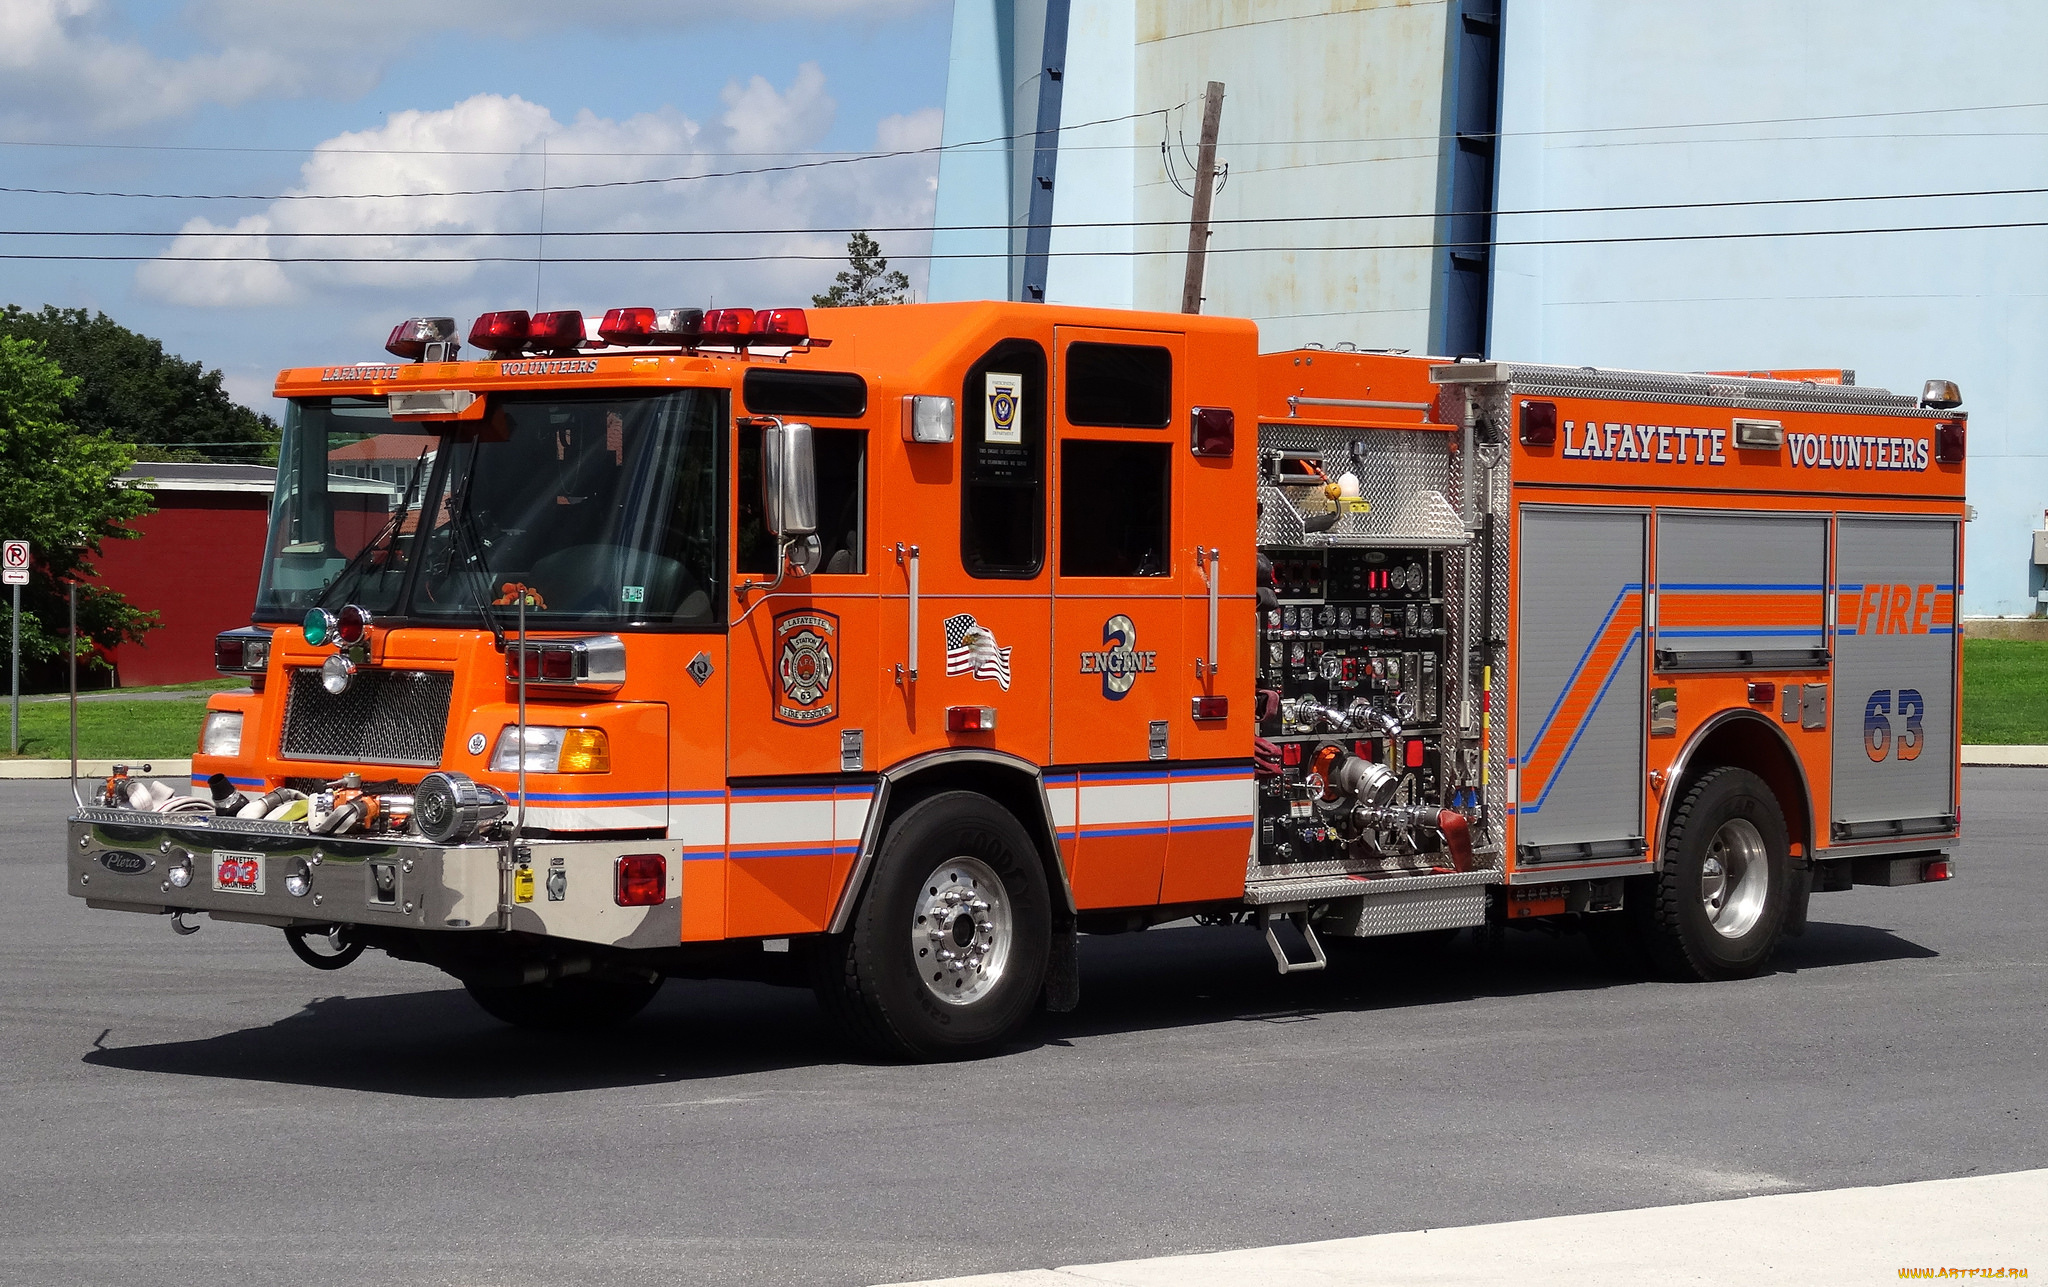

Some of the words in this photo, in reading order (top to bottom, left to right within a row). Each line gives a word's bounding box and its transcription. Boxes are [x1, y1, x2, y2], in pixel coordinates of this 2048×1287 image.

[321, 366, 400, 382] LAFAYETTE
[501, 359, 599, 376] VOLUNTEERS
[1562, 420, 1727, 466] LAFAYETTE
[1787, 433, 1930, 473] VOLUNTEERS
[1857, 583, 1935, 635] FIRE
[787, 616, 827, 627] LAFAYETTE
[795, 636, 818, 646] STATION
[1080, 651, 1157, 674] ENGINE
[1102, 613, 1137, 702] 3
[800, 691, 812, 700] 63
[1863, 688, 1924, 763] 63
[106, 851, 142, 869] Pierce
